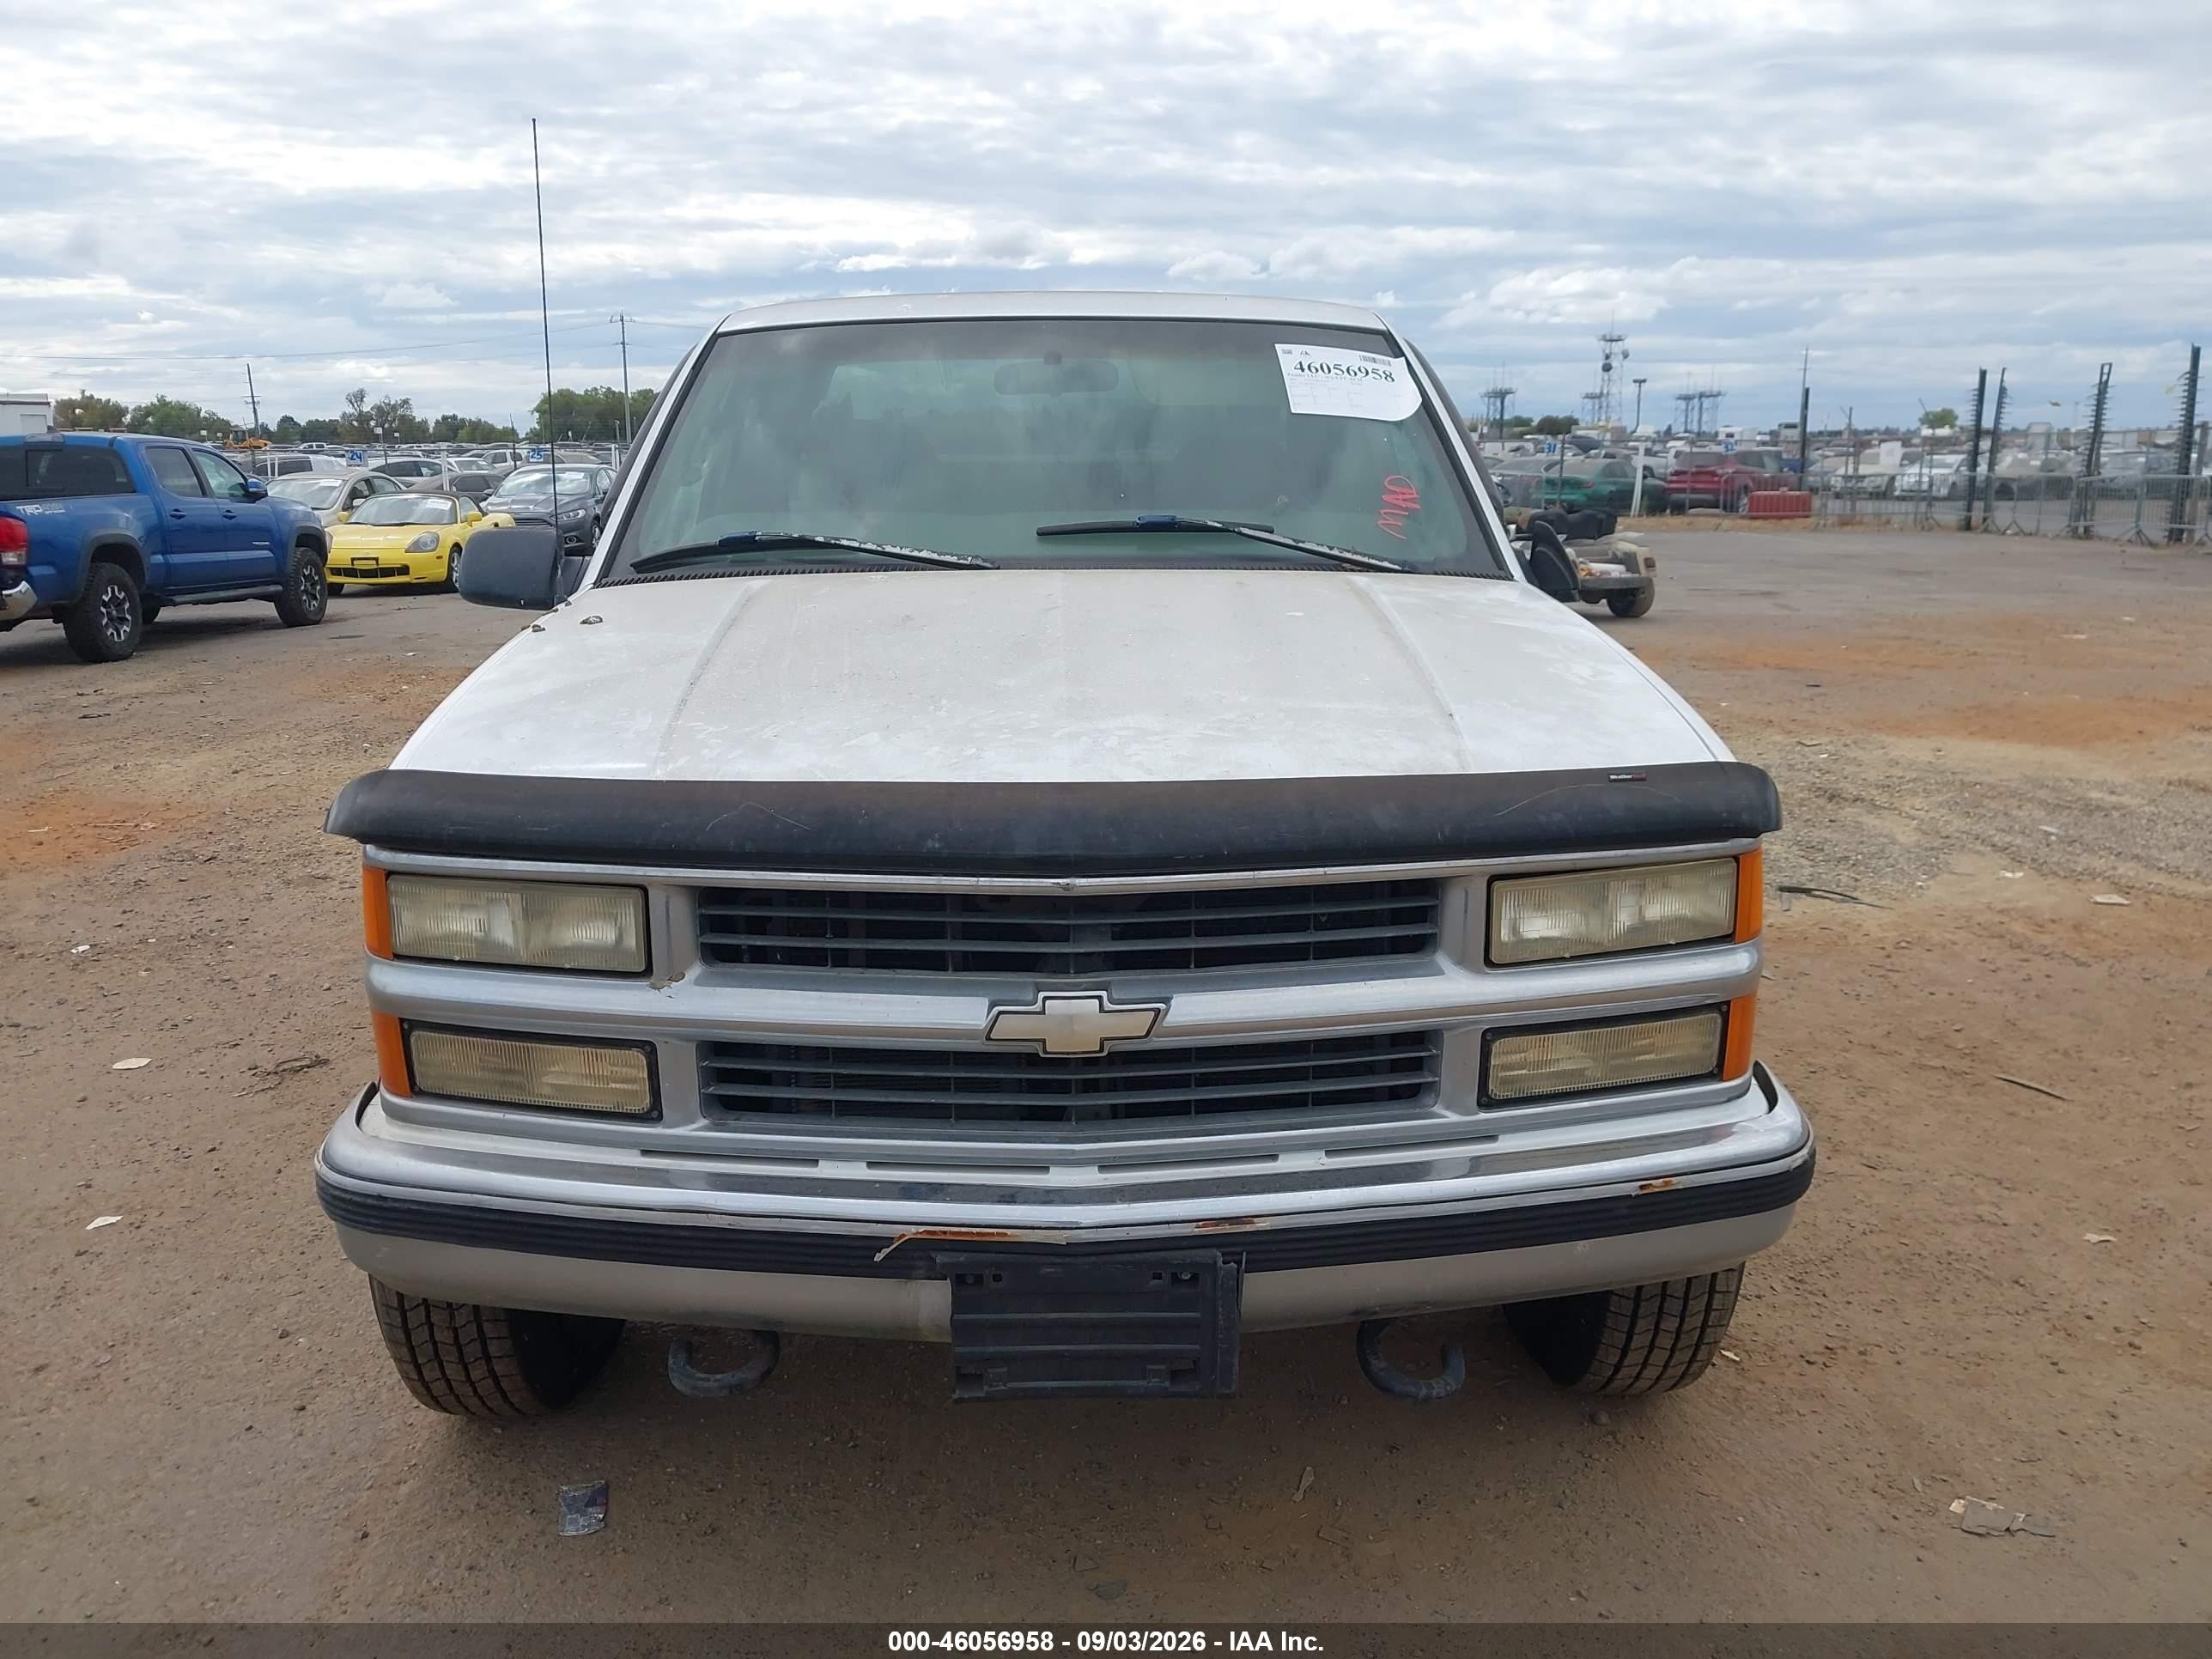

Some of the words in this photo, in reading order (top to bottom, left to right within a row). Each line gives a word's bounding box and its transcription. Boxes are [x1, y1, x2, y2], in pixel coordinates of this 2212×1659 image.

[1293, 360, 1395, 383] 46056958
[349, 450, 362, 463] 24
[530, 447, 544, 460] 25
[15, 504, 43, 516] TRD
